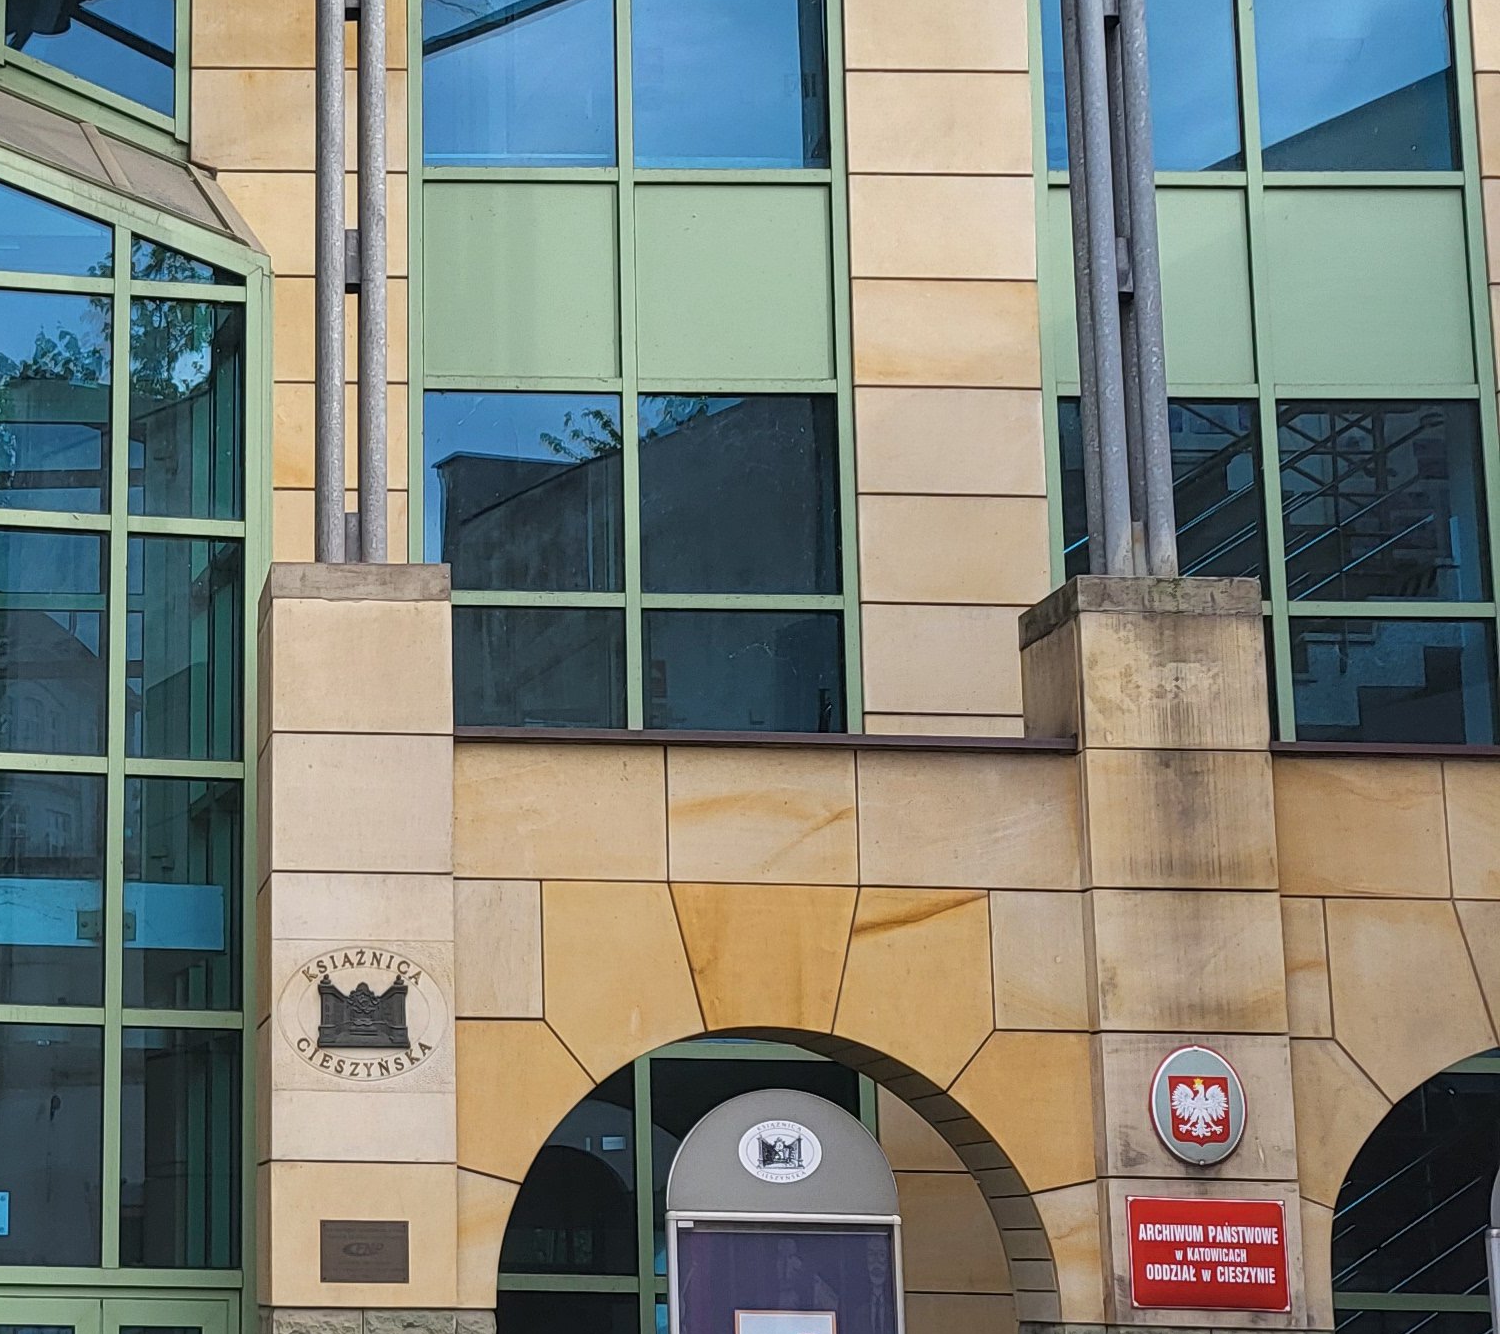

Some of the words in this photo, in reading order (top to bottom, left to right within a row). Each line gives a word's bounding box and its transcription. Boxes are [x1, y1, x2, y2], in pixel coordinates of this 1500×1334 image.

[301, 948, 423, 986] KSIĄŻNICA
[296, 1037, 433, 1077] CIESZYŃSKA
[1138, 1224, 1203, 1242] ARCHIWUM
[1208, 1222, 1279, 1245] PAŃSTWOWE
[1187, 1247, 1247, 1263] KATOWICACH
[1146, 1264, 1197, 1282] ODDZIAŁ
[1217, 1266, 1276, 1284] CIESZYNIE
